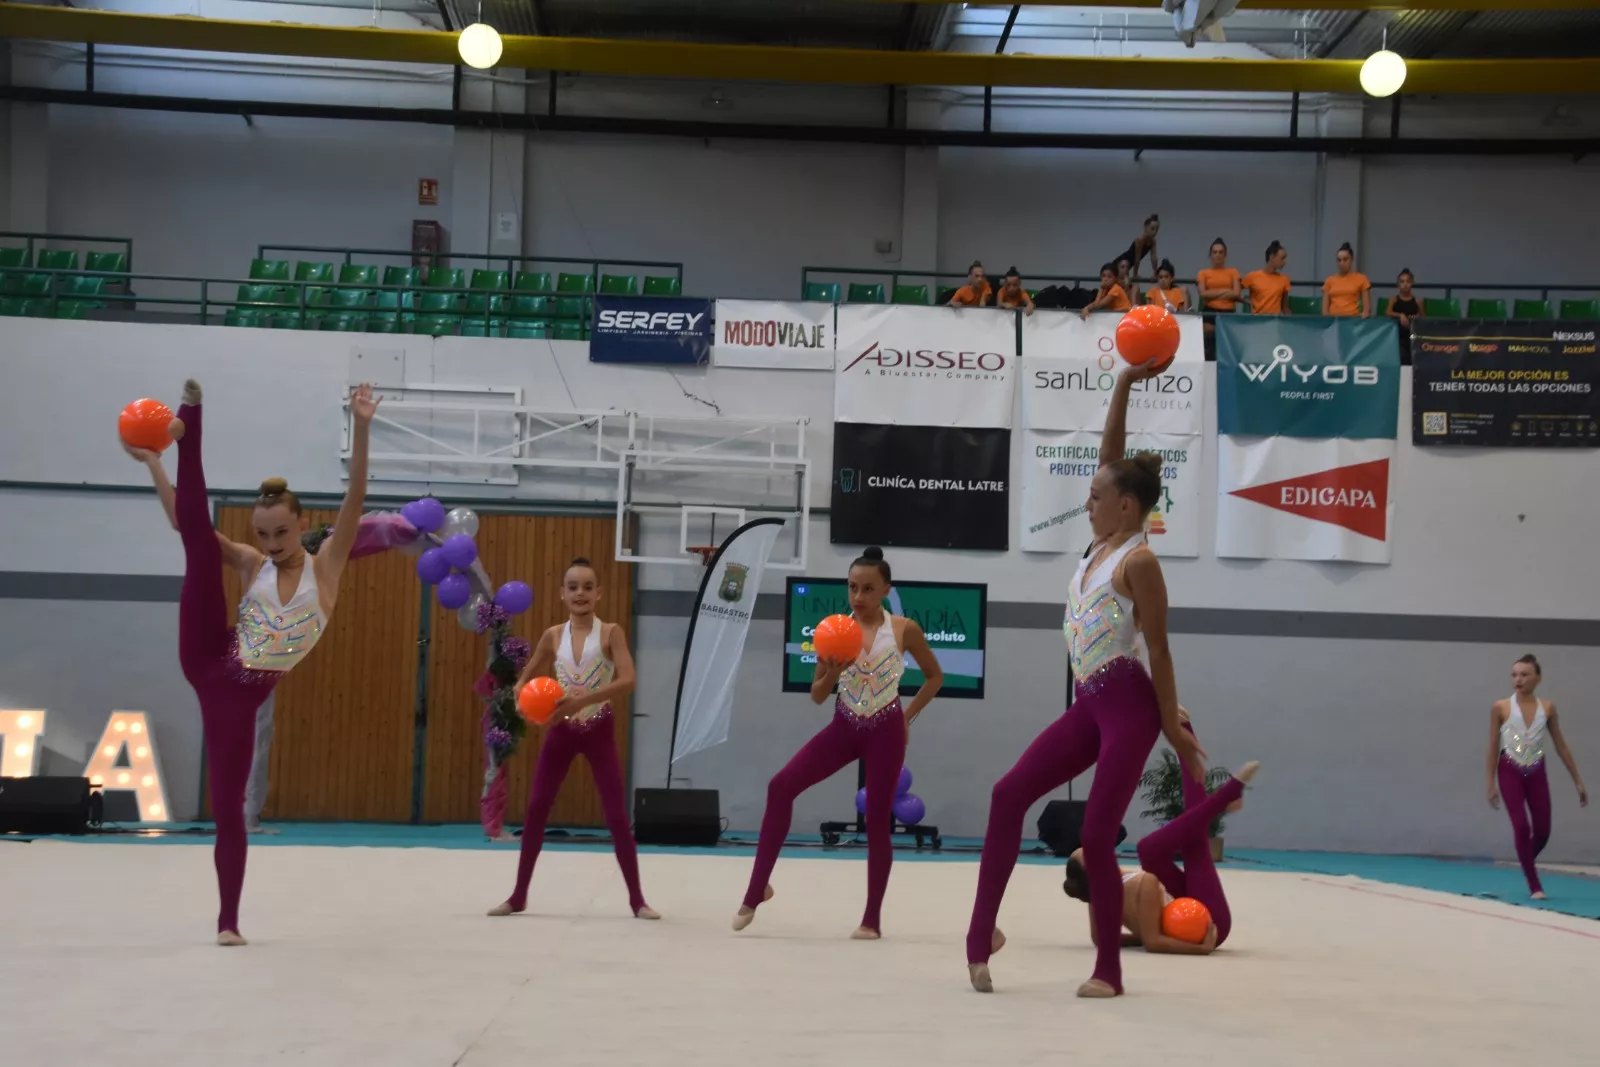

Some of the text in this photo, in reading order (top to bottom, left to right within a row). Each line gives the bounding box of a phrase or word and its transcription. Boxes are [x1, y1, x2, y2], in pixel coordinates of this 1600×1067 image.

[598, 310, 704, 331] SERFEY
[724, 320, 825, 348] MODOVIAJE
[843, 341, 1005, 372] ADISSEO
[865, 368, 1005, 382] A Bluestar Company
[1452, 368, 1569, 381] LA MEJOR OPCIÓN ES
[1429, 382, 1592, 394] TENER TODAS LAS OPCIONES
[1280, 391, 1335, 401] PEOPLE FIRST
[1036, 445, 1102, 460] CERTIFICAD
[1050, 462, 1101, 477] PROYECT
[919, 479, 965, 491] DENTAL
[968, 481, 1004, 492] LATRE
[1280, 486, 1377, 509] EDIGAPA
[701, 603, 750, 619] BARBASTRO
